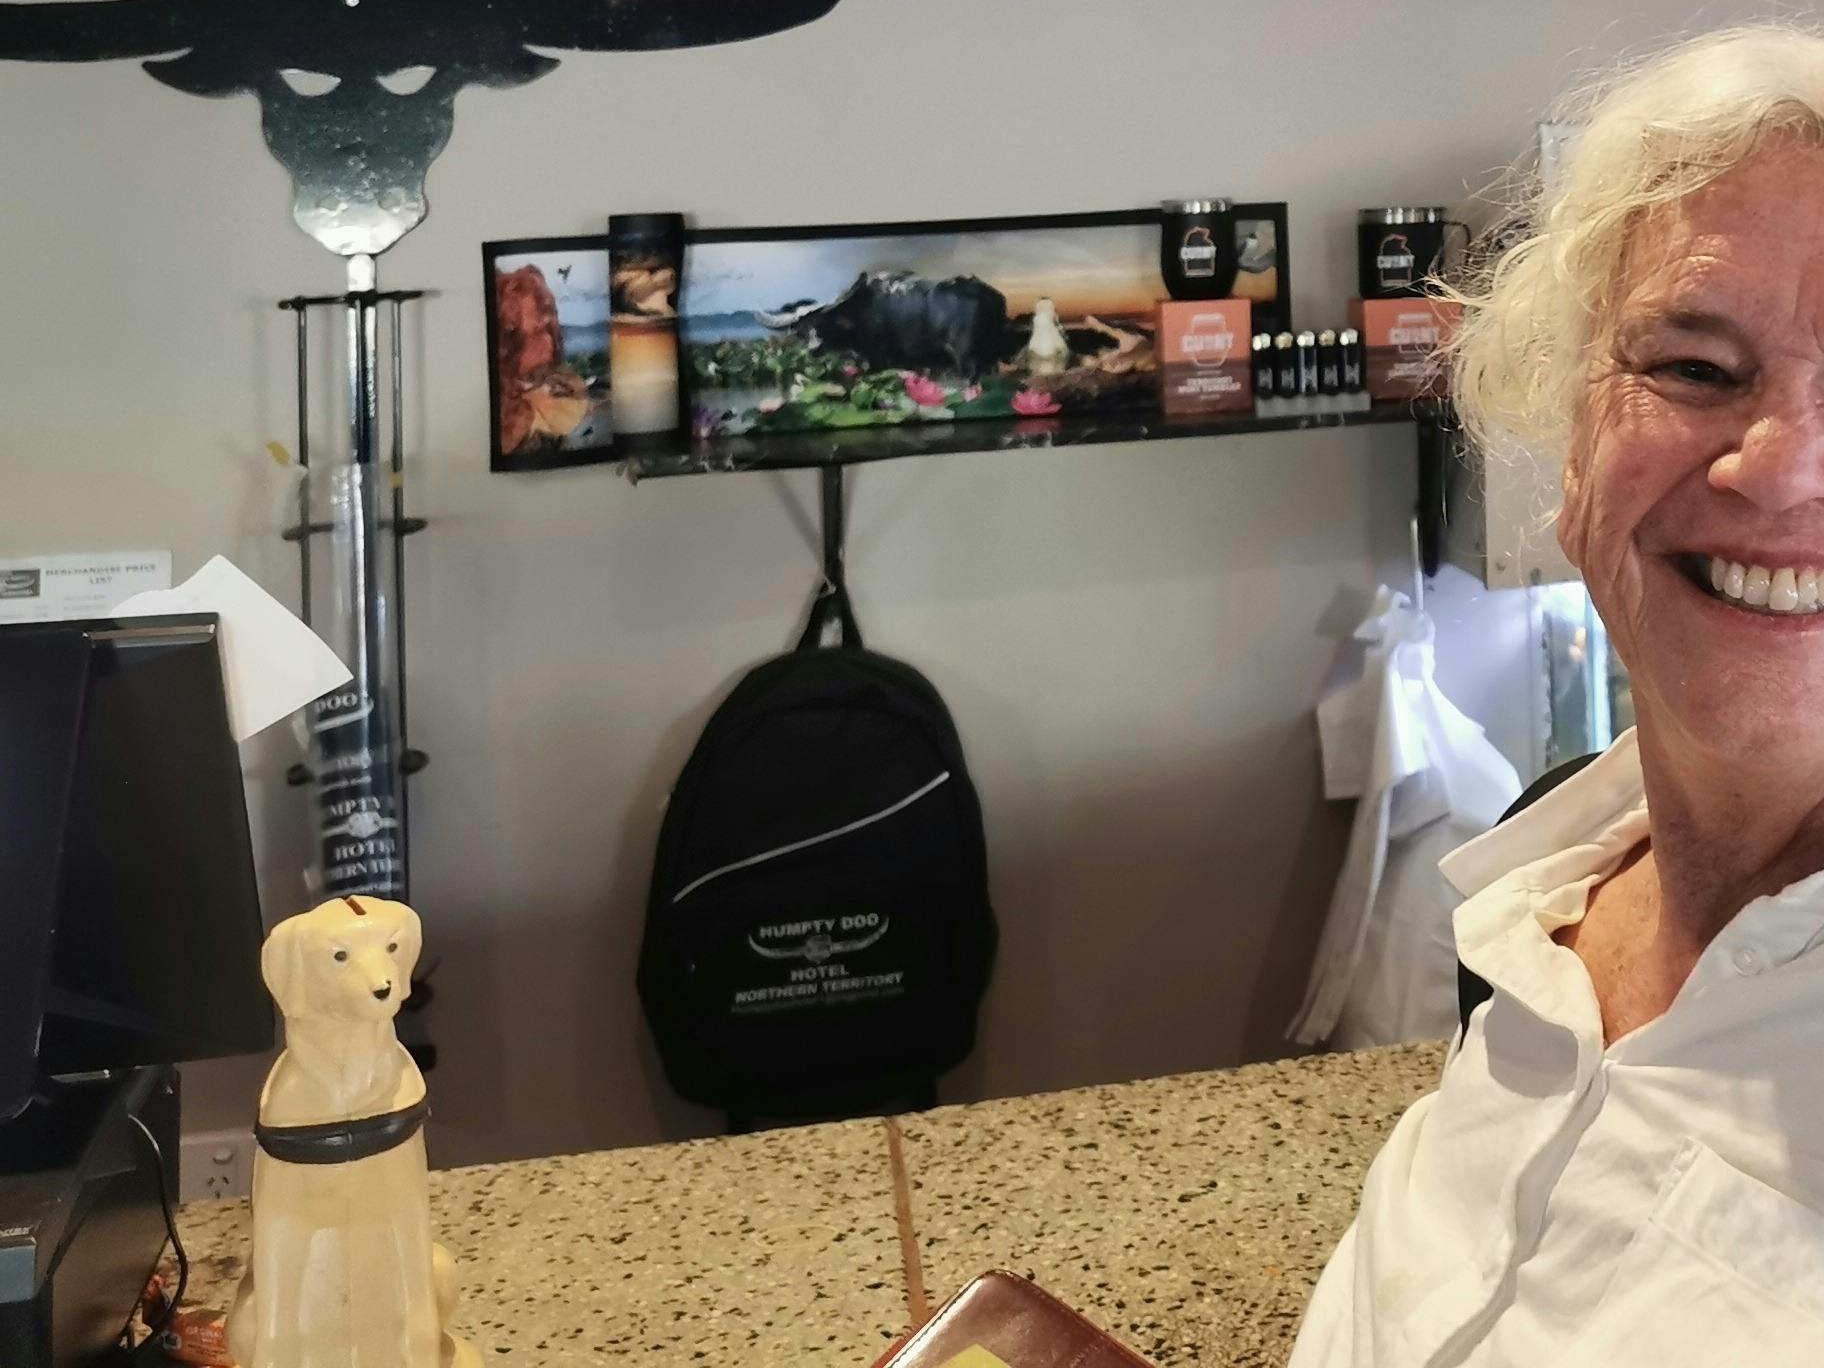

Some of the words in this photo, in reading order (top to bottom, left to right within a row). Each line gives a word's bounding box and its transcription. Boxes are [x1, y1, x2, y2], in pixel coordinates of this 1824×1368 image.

[760, 919, 835, 938] HUMPTY
[842, 912, 880, 930] DOO
[790, 963, 849, 981] HOTEL
[735, 983, 818, 1004] NORTHERN
[822, 971, 904, 992] TERRITORY
